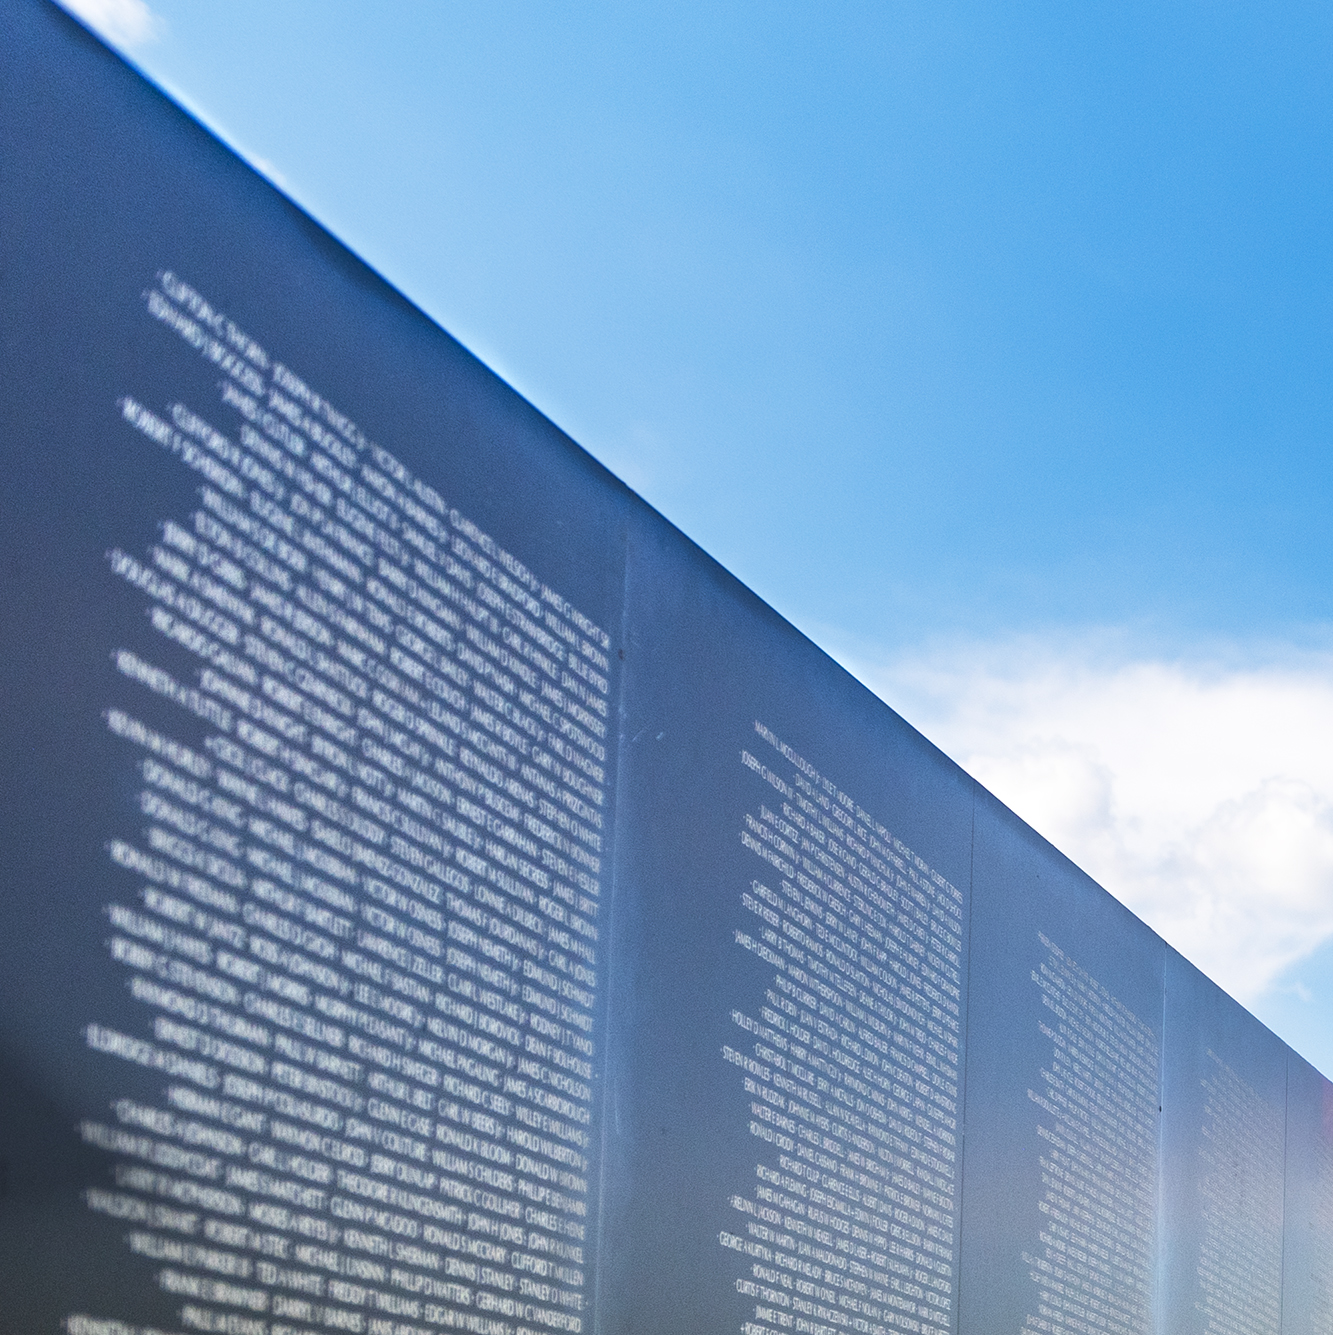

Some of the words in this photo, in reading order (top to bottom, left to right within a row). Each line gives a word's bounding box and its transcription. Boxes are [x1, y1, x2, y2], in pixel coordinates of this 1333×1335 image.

[541, 582, 563, 616] JAMES
[541, 678, 563, 710] JAMES
[561, 670, 578, 696] DAN
[585, 688, 606, 720] JAMES
[519, 685, 551, 723] MICHAEL
[559, 715, 604, 761] SPOTSWOOD
[547, 924, 569, 952] JAMES
[578, 941, 594, 964] HALL
[548, 949, 567, 973] CARL
[573, 962, 594, 989] JONES
[518, 1056, 540, 1082] JAMES
[547, 1069, 590, 1102] NICHOLSON
[515, 1154, 549, 1181] DONALD
[558, 1170, 586, 1195] BROWN
[756, 1163, 780, 1187] RICHARD
[784, 1176, 806, 1198] FLEMING
[719, 1230, 742, 1252] GEORGE
[475, 1292, 514, 1316] GERHARD
[531, 1307, 580, 1333] VANDERFORD
[519, 1278, 550, 1301] STANLEY
[558, 1289, 581, 1310] WHITE
